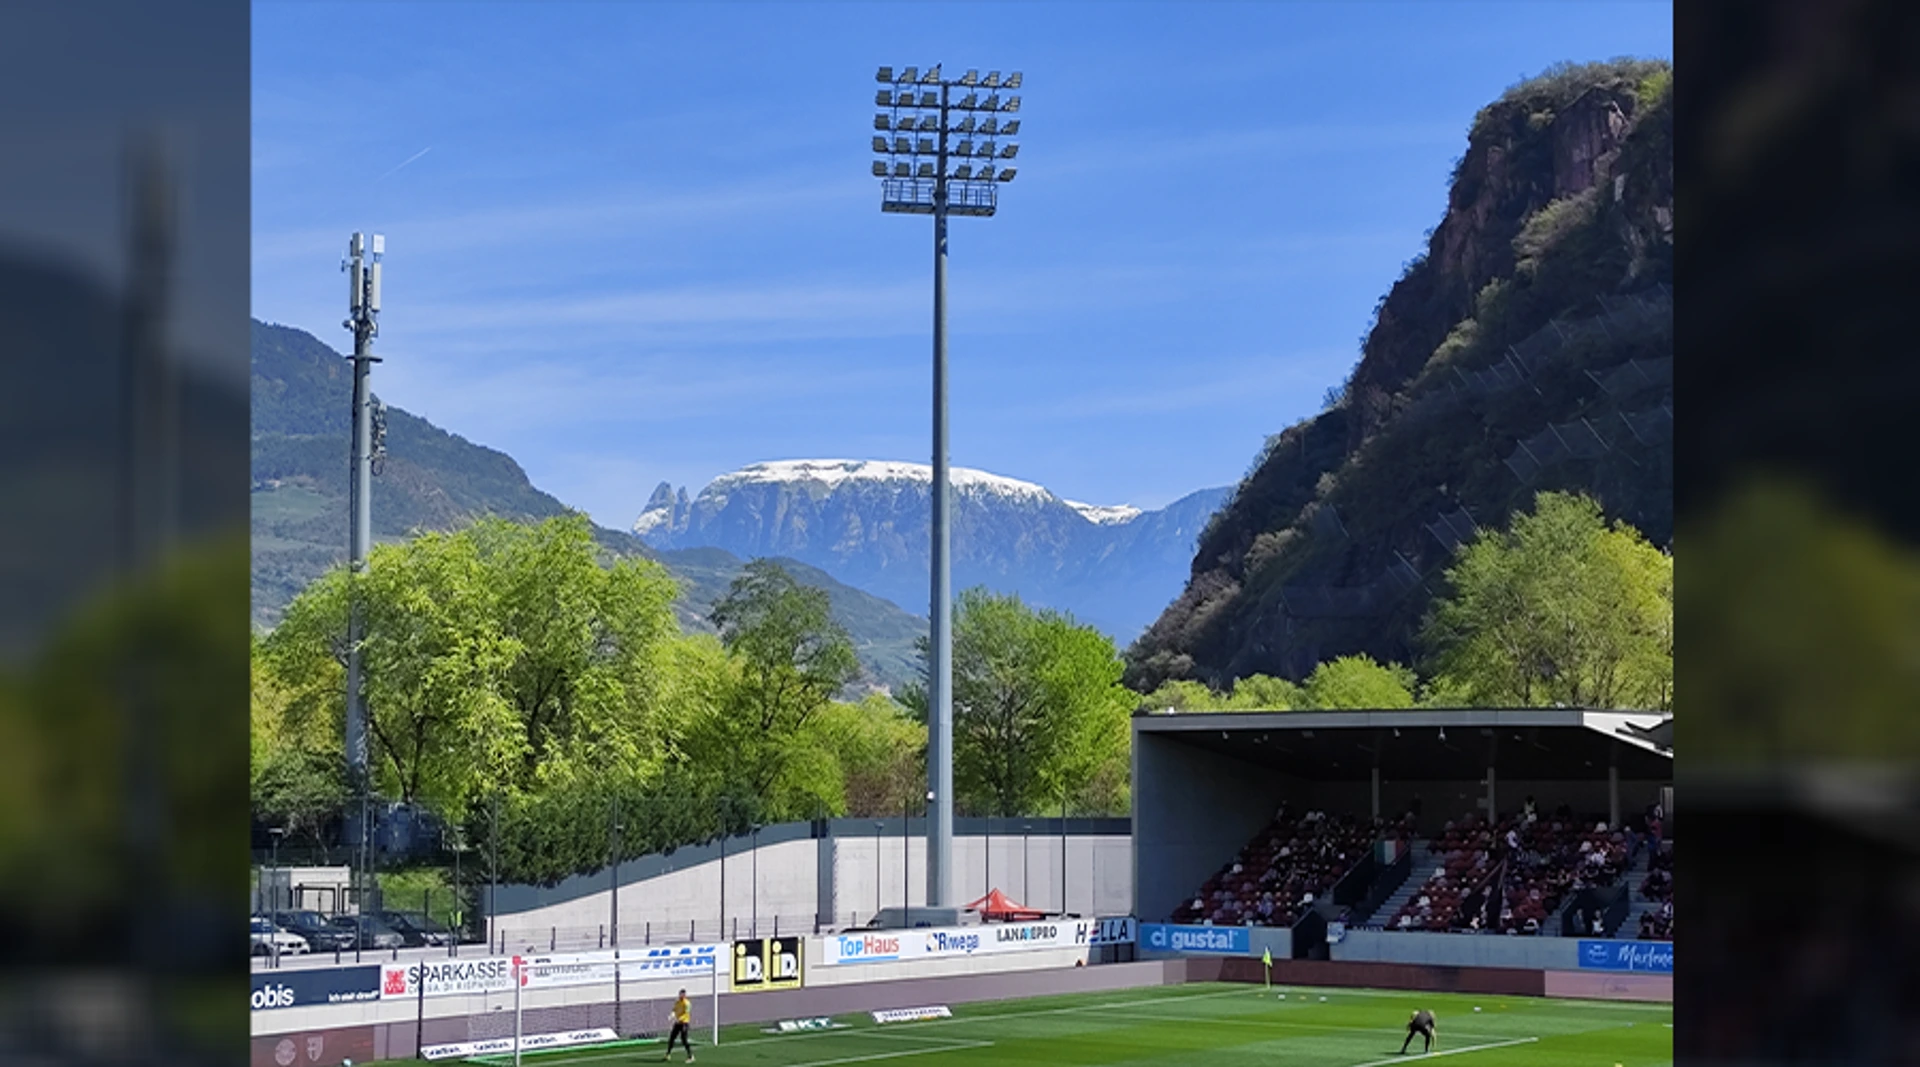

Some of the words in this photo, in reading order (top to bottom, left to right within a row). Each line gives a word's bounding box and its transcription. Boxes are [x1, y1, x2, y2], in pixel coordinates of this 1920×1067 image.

[837, 935, 899, 956] TopHaus
[1151, 927, 1166, 946] ci
[1171, 929, 1234, 949] gusta!
[408, 960, 507, 984] SPARKASSE
